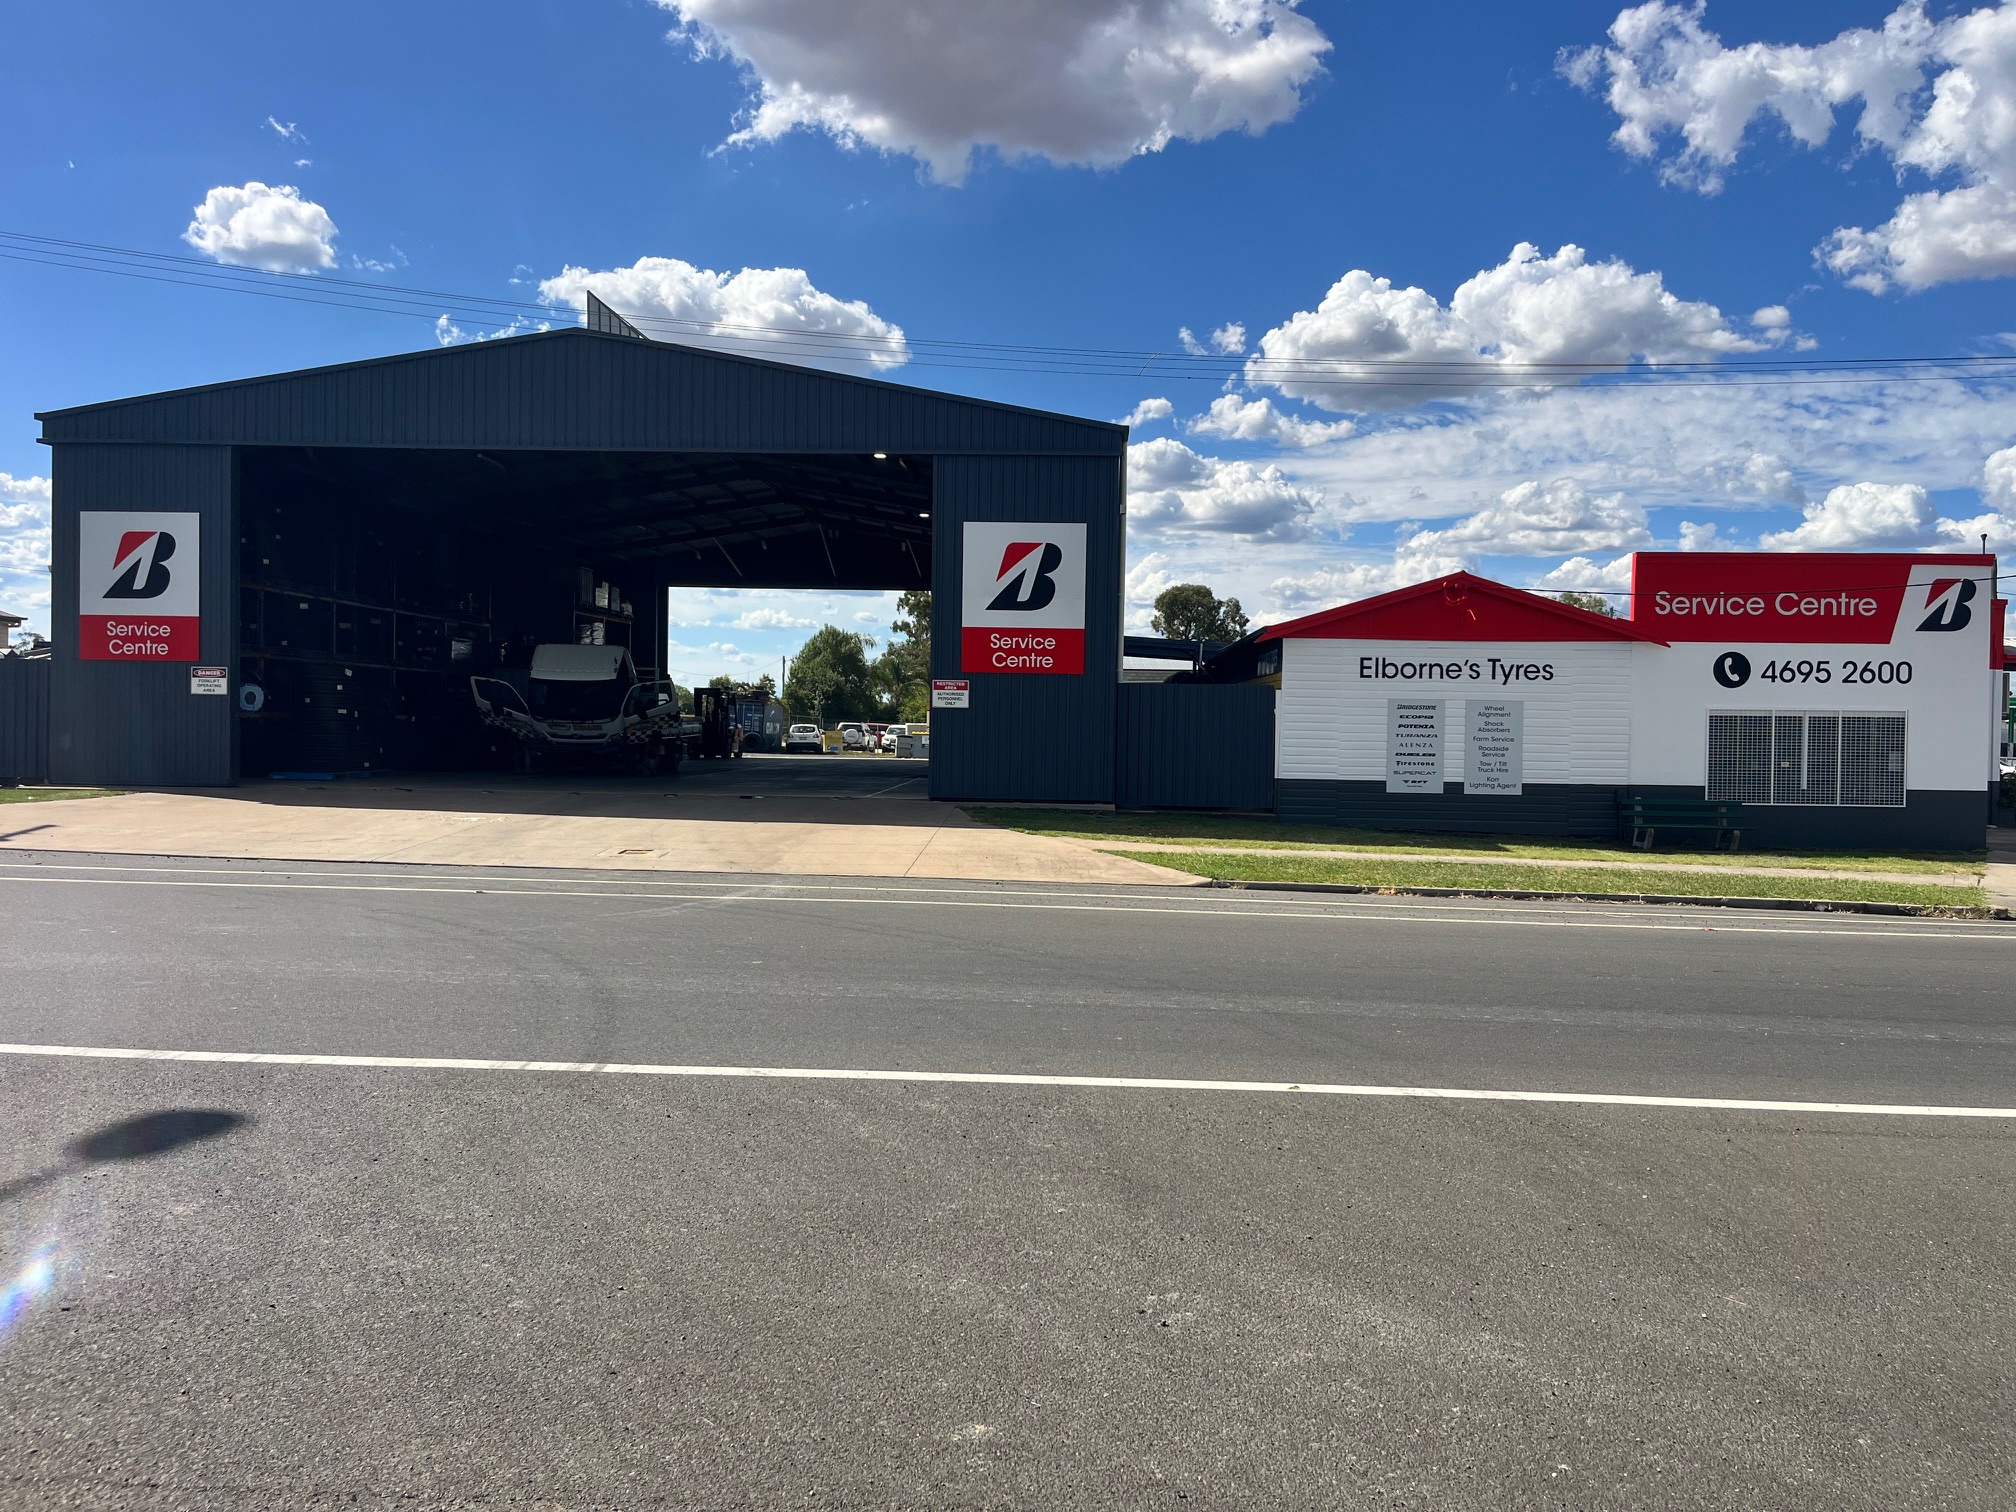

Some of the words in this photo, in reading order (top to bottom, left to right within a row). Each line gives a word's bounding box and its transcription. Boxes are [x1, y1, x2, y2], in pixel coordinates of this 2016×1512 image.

[1655, 591, 1764, 616] Service
[1775, 592, 1877, 616] Centre
[107, 621, 170, 637] Service
[109, 639, 168, 655] Centre
[990, 633, 1056, 649] Service
[992, 652, 1053, 667] Centre
[1360, 657, 1480, 680] Elborne's
[1487, 658, 1554, 685] Tyres
[1761, 661, 1831, 683] 4695
[1842, 661, 1913, 684] 2600
